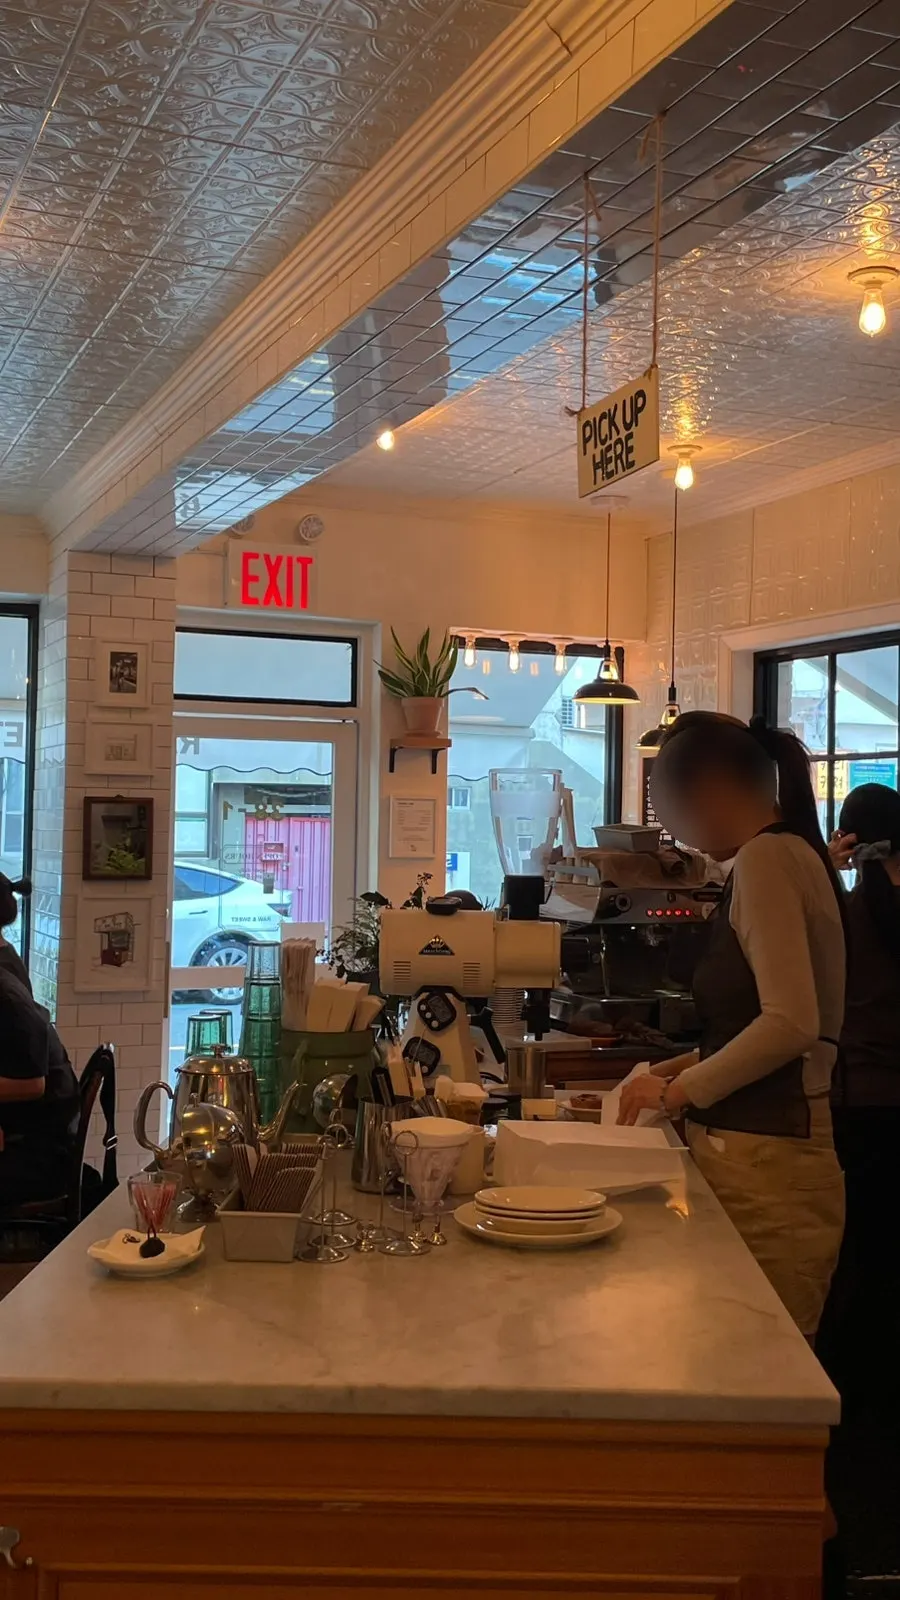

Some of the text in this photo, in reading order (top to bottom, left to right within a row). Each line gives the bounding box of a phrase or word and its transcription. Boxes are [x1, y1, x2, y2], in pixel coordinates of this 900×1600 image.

[582, 389, 647, 456] PICK UP
[592, 432, 636, 485] HERE
[242, 552, 313, 609] EXIT
